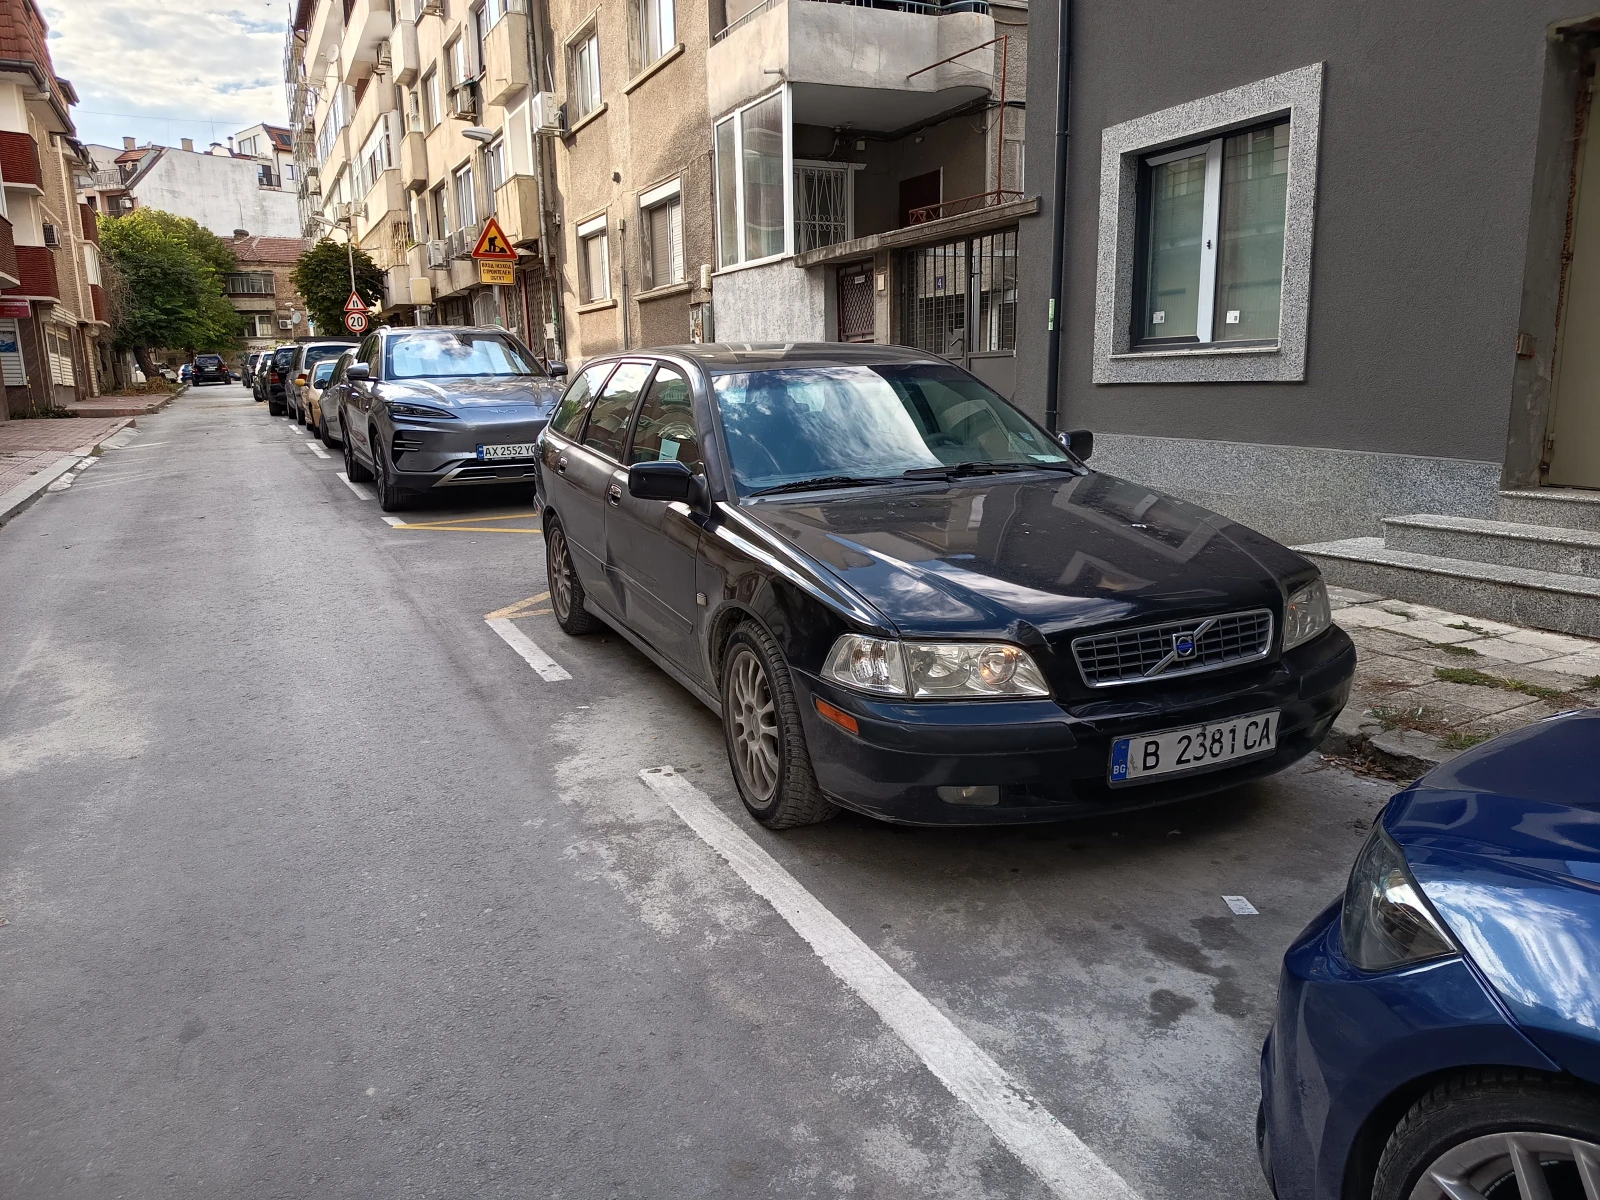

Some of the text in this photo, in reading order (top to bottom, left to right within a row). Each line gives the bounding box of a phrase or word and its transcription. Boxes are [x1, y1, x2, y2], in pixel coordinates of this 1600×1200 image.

[350, 316, 363, 327] 20
[485, 446, 499, 457] AX
[500, 445, 523, 456] 2552
[1142, 740, 1160, 772] B
[1113, 764, 1126, 775] BG
